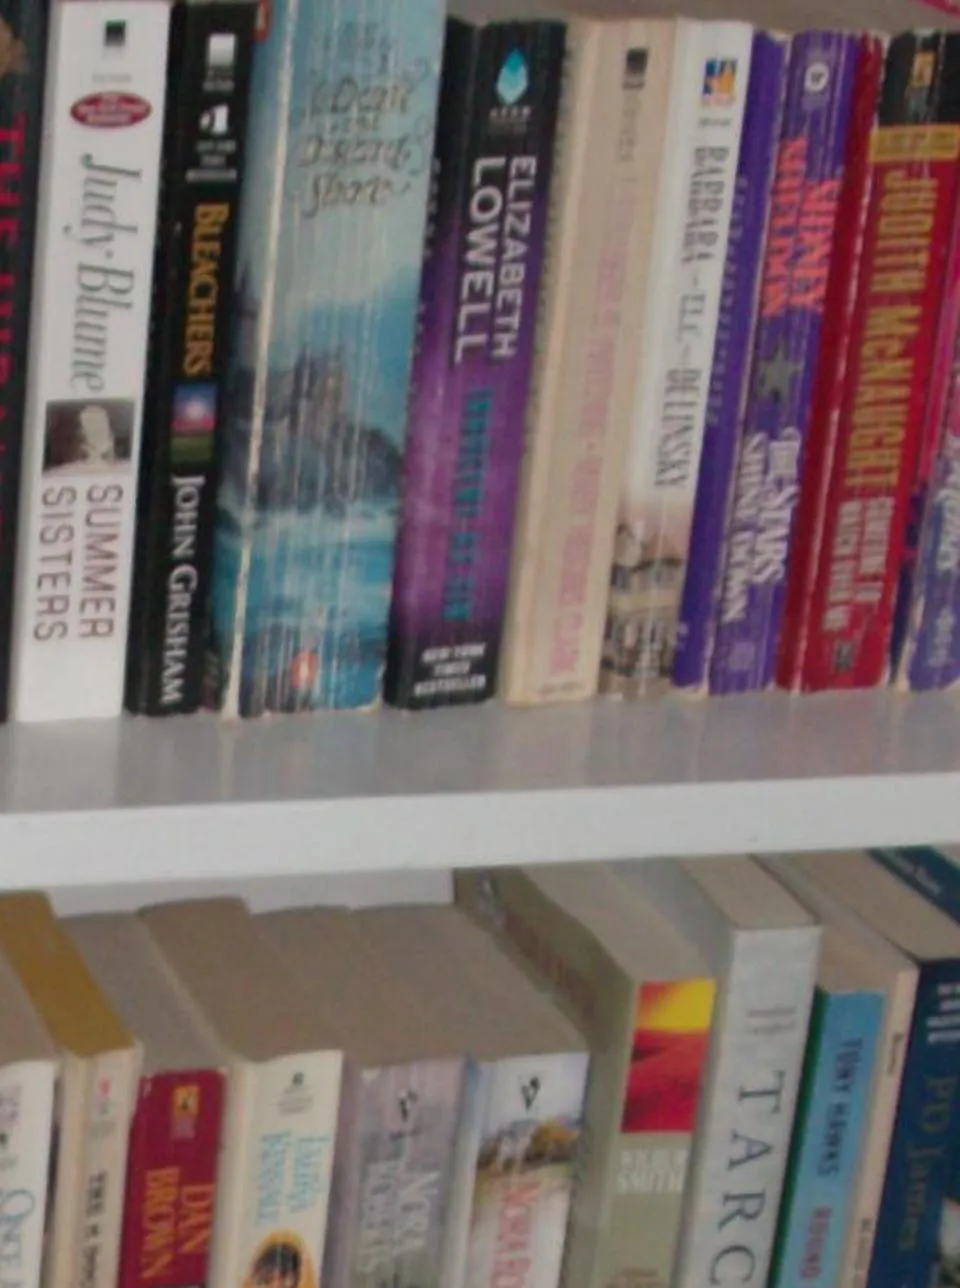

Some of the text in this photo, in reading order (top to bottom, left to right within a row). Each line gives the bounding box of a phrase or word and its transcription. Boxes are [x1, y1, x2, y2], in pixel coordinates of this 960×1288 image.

[63, 153, 142, 251] Judy
[452, 156, 506, 365] LOWELL
[490, 156, 539, 358] ELIZABETH
[787, 172, 842, 316] SIDNEY
[868, 169, 939, 293] JUDITH
[69, 255, 136, 393] Blume
[182, 203, 231, 374] BLEACHERS
[650, 146, 732, 491] BARBARA DELINSKY
[842, 304, 922, 491] McNAUGHT
[32, 485, 77, 642] SISTERS
[77, 483, 125, 640] SUMMER
[158, 474, 208, 707] JOHN GRISHAM
[750, 482, 802, 585] STARS
[816, 1036, 865, 1178] TONY HAWKS
[87, 1170, 108, 1218] THE
[139, 1166, 181, 1280] BROWN
[177, 1182, 214, 1253] DAN
[357, 1155, 402, 1274] ROBERTS
[391, 1169, 441, 1255] NORA
[801, 1206, 833, 1280] ROUND
